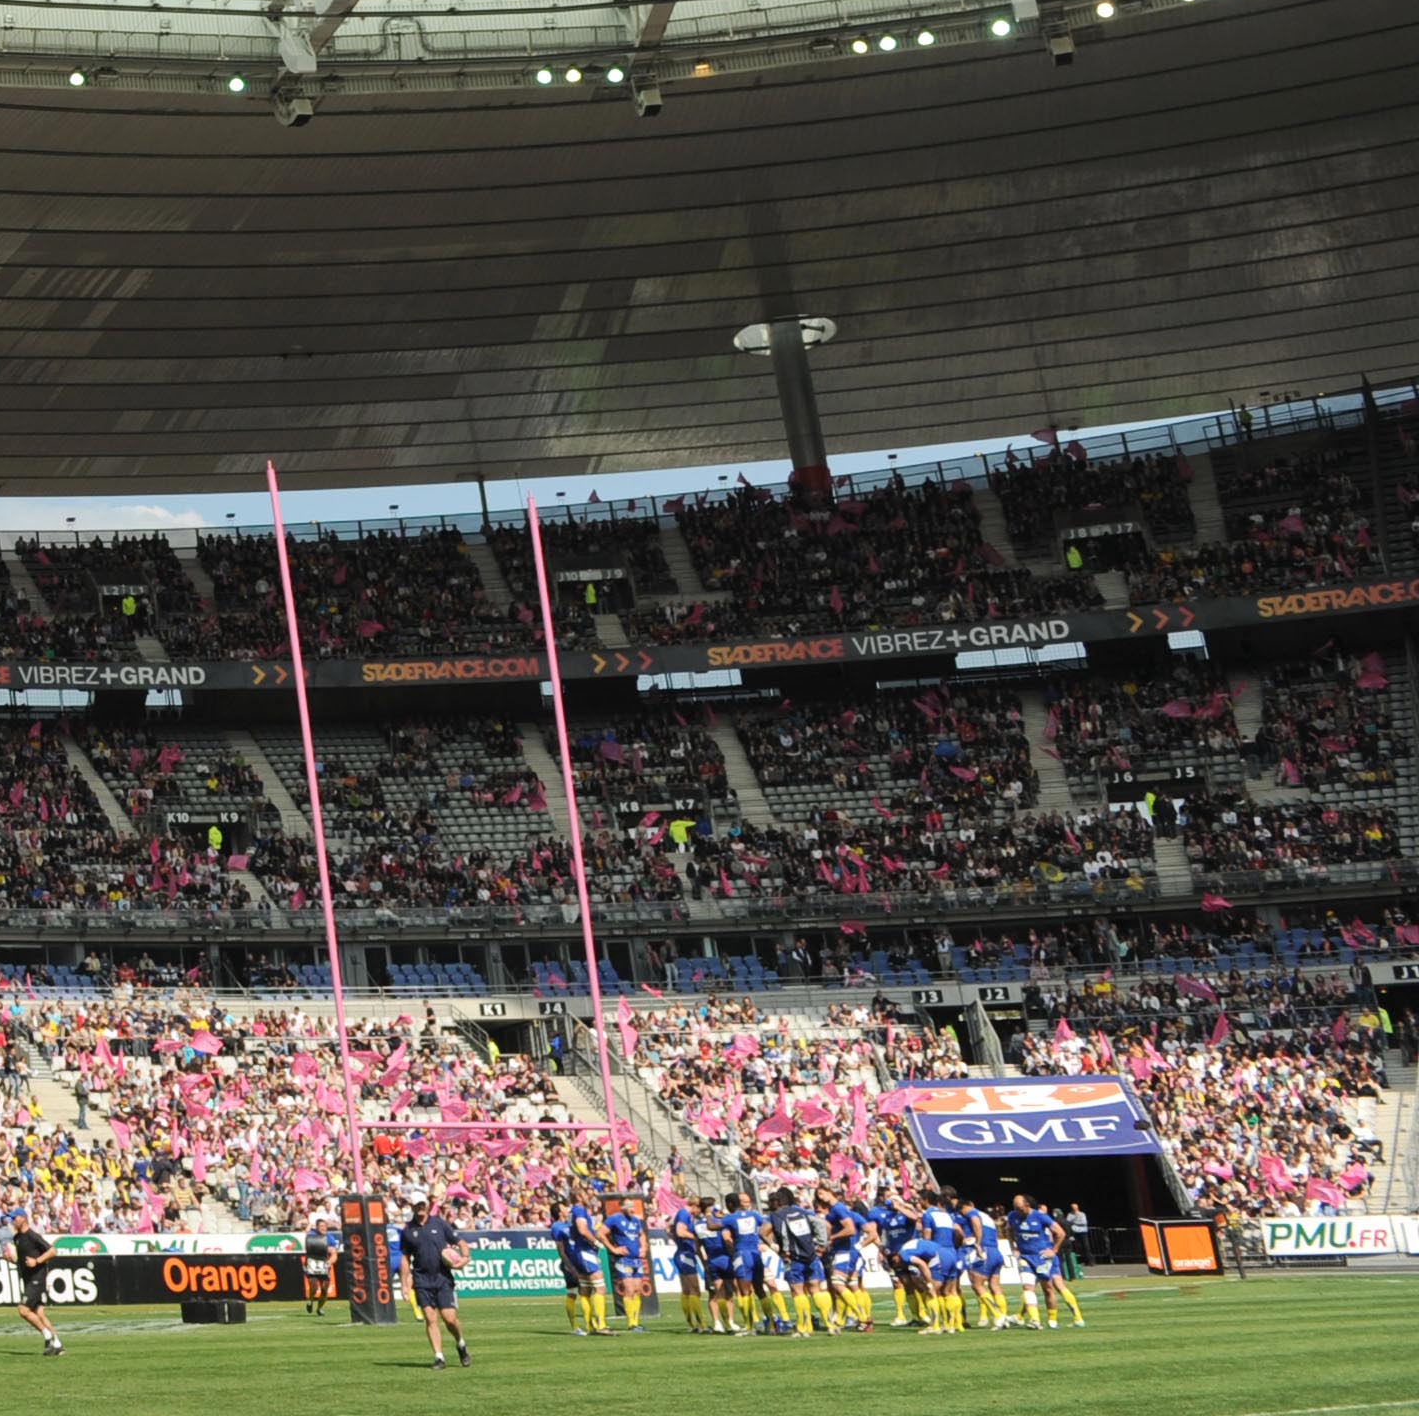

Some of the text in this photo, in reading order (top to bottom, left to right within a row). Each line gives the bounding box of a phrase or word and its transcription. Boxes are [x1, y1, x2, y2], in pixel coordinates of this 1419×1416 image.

[707, 637, 844, 667] STADEFRANCE
[362, 657, 541, 683] STADEFRANCE.COM
[1113, 766, 1195, 784] J6 J5
[619, 798, 695, 814] K8 K7
[167, 811, 240, 824] K10 K9
[919, 989, 940, 1004] J3
[986, 986, 1006, 1001] J2
[482, 1002, 504, 1016] K1
[545, 1001, 564, 1015] J4
[938, 1115, 1121, 1147] GMF
[374, 1233, 391, 1305] Orange
[454, 1259, 566, 1278] REDIT AGRIC
[163, 1256, 278, 1300] Orange
